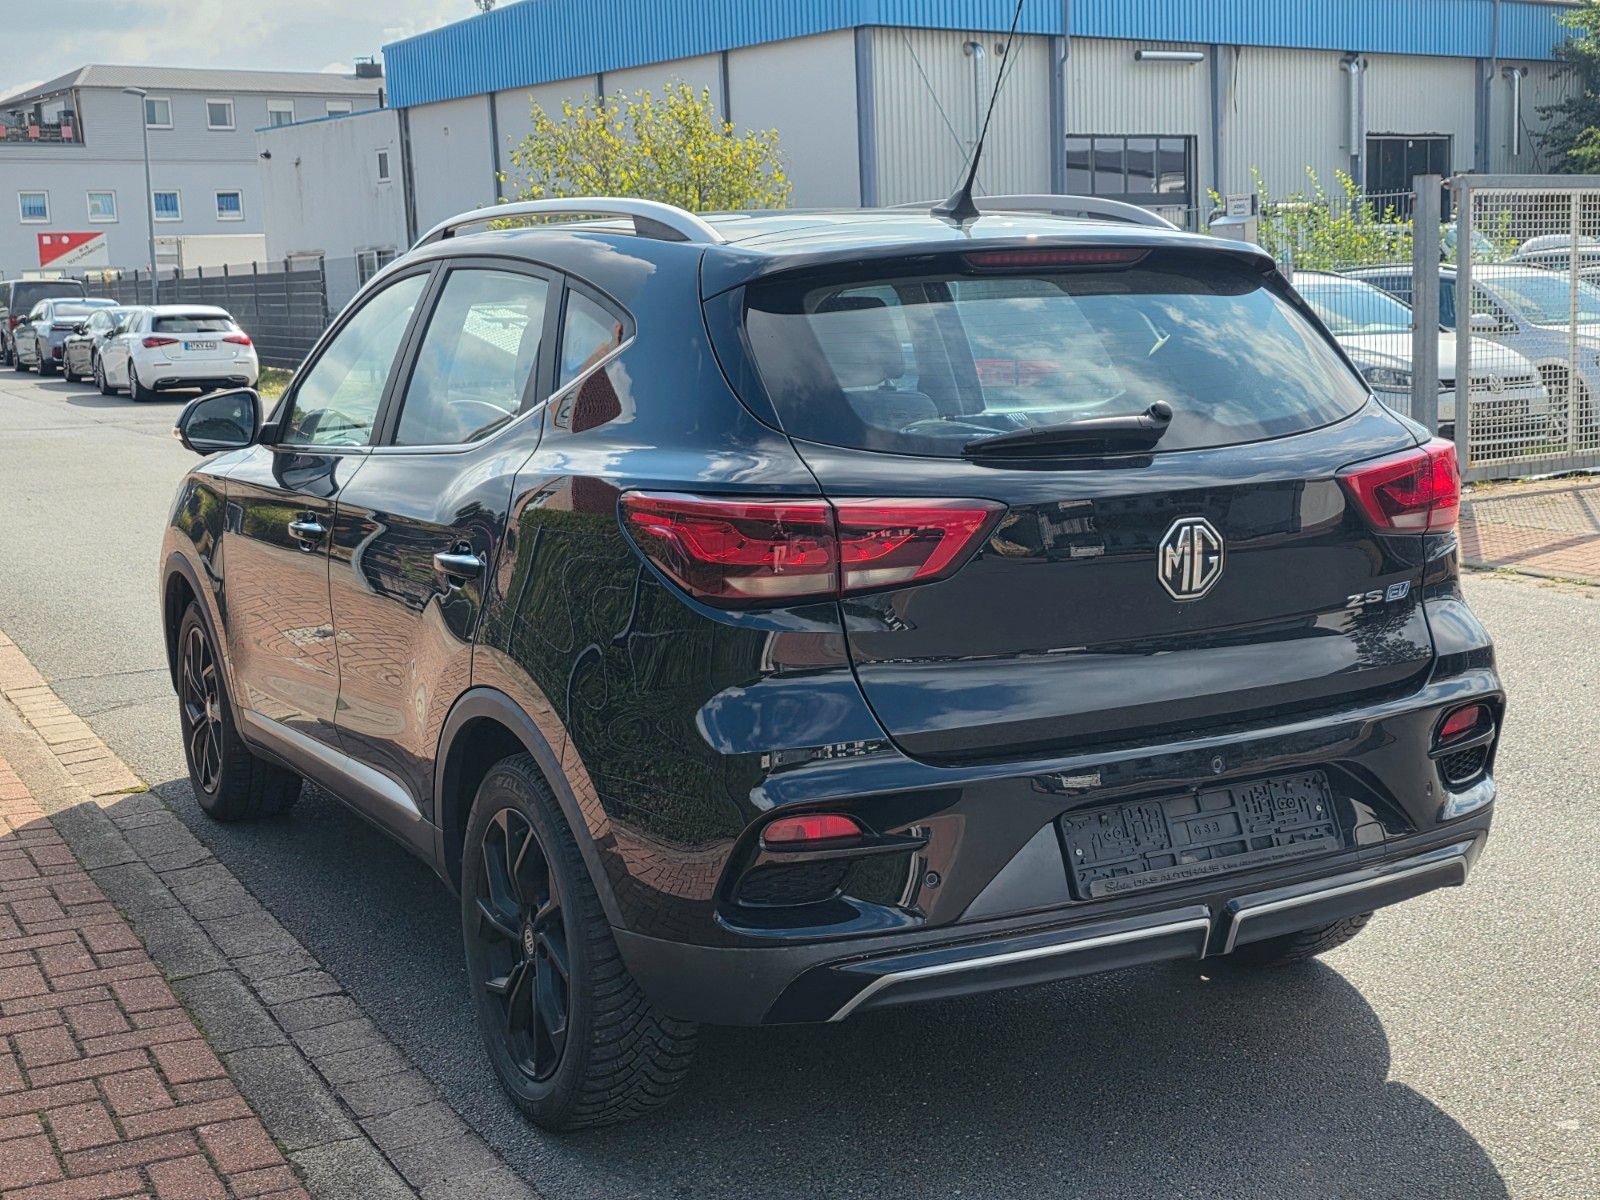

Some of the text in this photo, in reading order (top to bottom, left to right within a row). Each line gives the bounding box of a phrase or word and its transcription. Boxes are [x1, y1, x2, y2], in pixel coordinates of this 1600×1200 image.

[1165, 524, 1220, 593] MG
[1346, 582, 1410, 609] ZS EV
